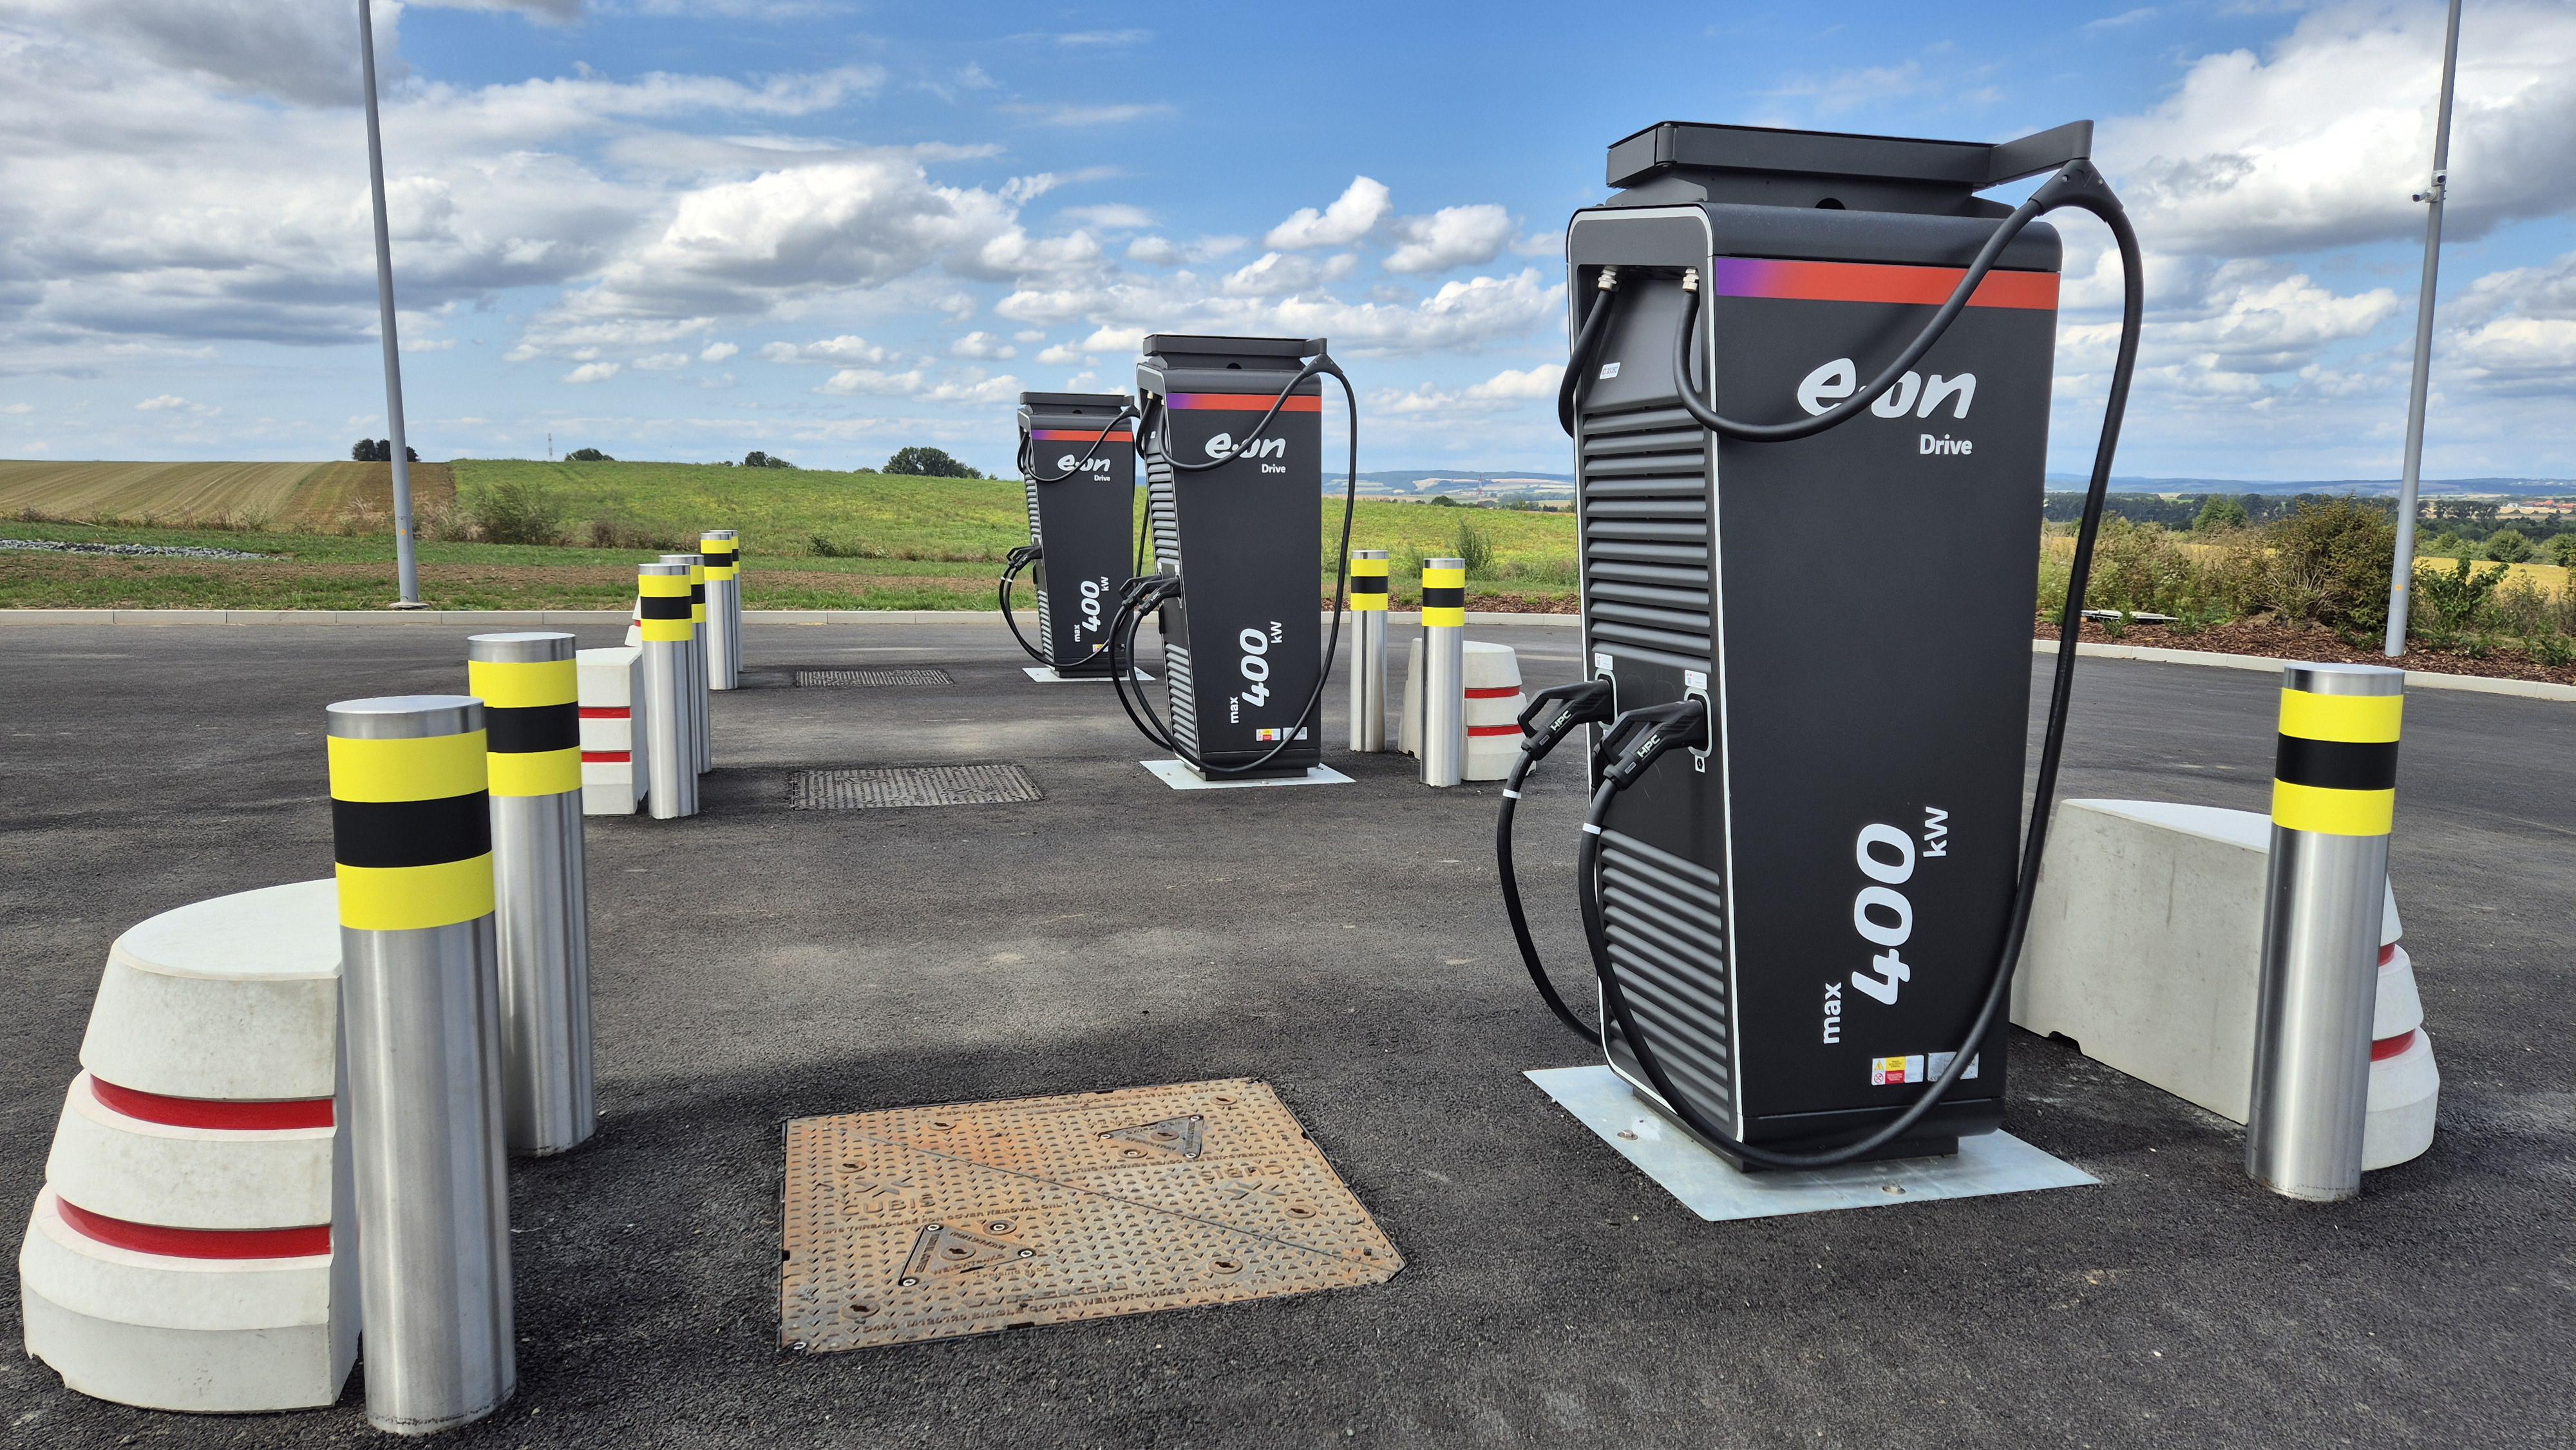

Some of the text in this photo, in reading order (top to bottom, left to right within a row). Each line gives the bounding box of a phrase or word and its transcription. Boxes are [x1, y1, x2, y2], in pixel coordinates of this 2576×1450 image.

[1920, 434, 1973, 455] Drive
[1262, 464, 1286, 473] Drive
[1101, 576, 1109, 591] kW
[1080, 580, 1101, 632] 400
[1270, 621, 1282, 643] kW
[1240, 628, 1270, 708] 400
[1229, 696, 1239, 724] max
[1550, 710, 1571, 731] HPC
[1636, 734, 1660, 758] HPC
[1923, 806, 1949, 858] kW
[1852, 823, 1915, 1005] 400
[1823, 982, 1841, 1044] max
[1196, 1162, 1287, 1182] CUBIS
[840, 1192, 936, 1216] CUBIS
[947, 1211, 983, 1220] COVER
[986, 1205, 1038, 1216] REMOVAL
